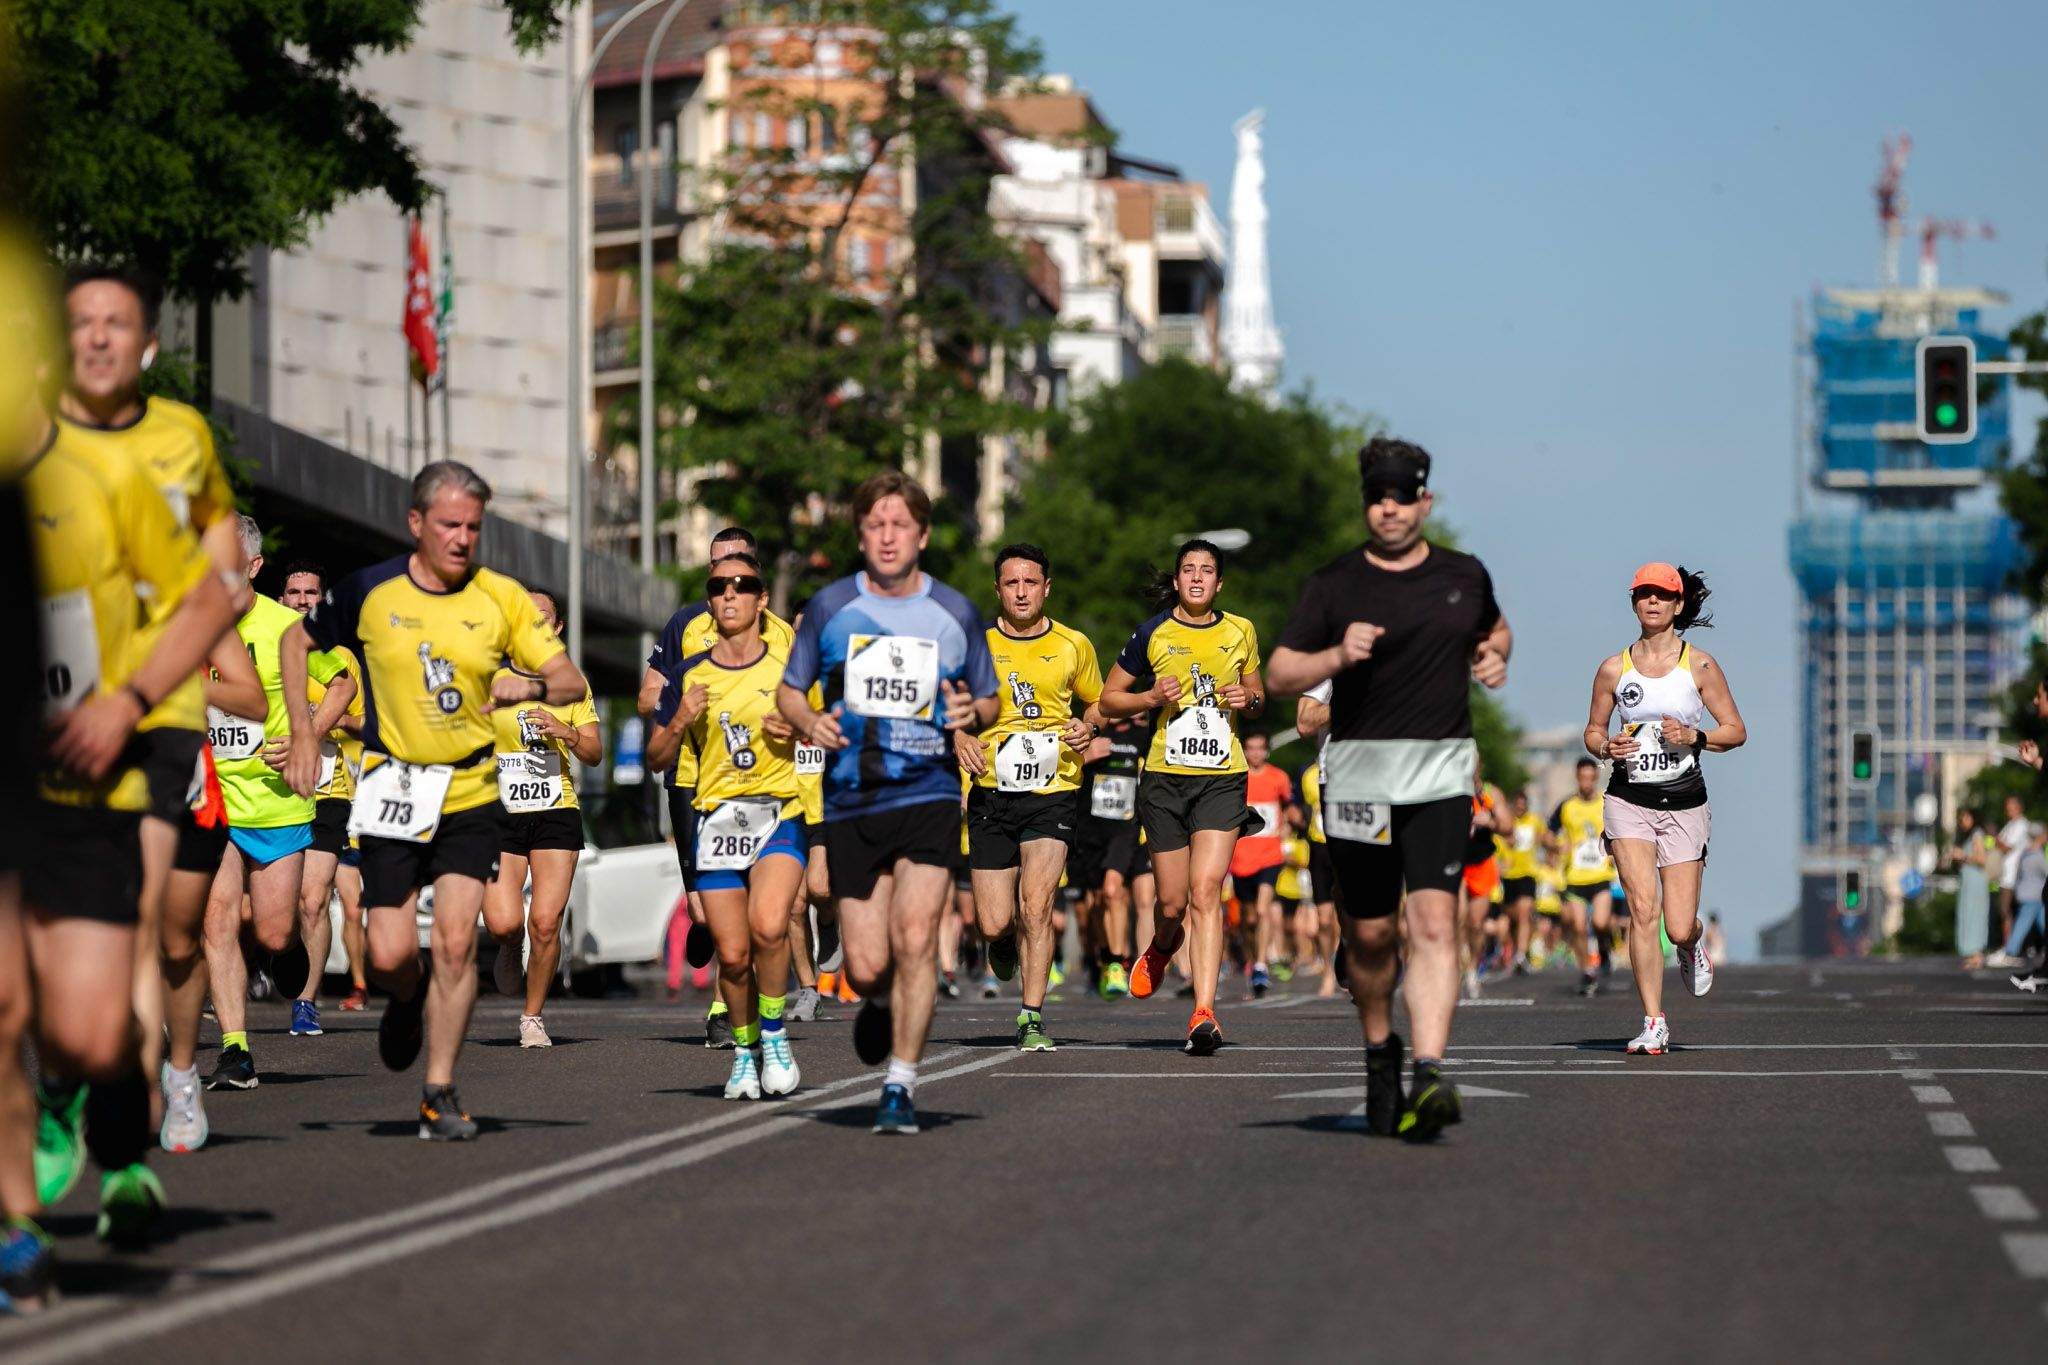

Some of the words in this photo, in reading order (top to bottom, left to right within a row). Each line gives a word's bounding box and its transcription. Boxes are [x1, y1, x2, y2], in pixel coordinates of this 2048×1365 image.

[863, 676, 918, 703] 1355
[440, 691, 460, 709] 13
[1025, 706, 1039, 717] 13
[209, 726, 249, 747] 3675
[797, 749, 823, 764] 970
[1179, 737, 1219, 757] 1848
[736, 752, 753, 767] 13
[1639, 752, 1680, 772] 3795
[1014, 763, 1040, 780] 791
[508, 781, 551, 801] 2626
[378, 798, 413, 825] 773
[1337, 801, 1375, 826] 1695
